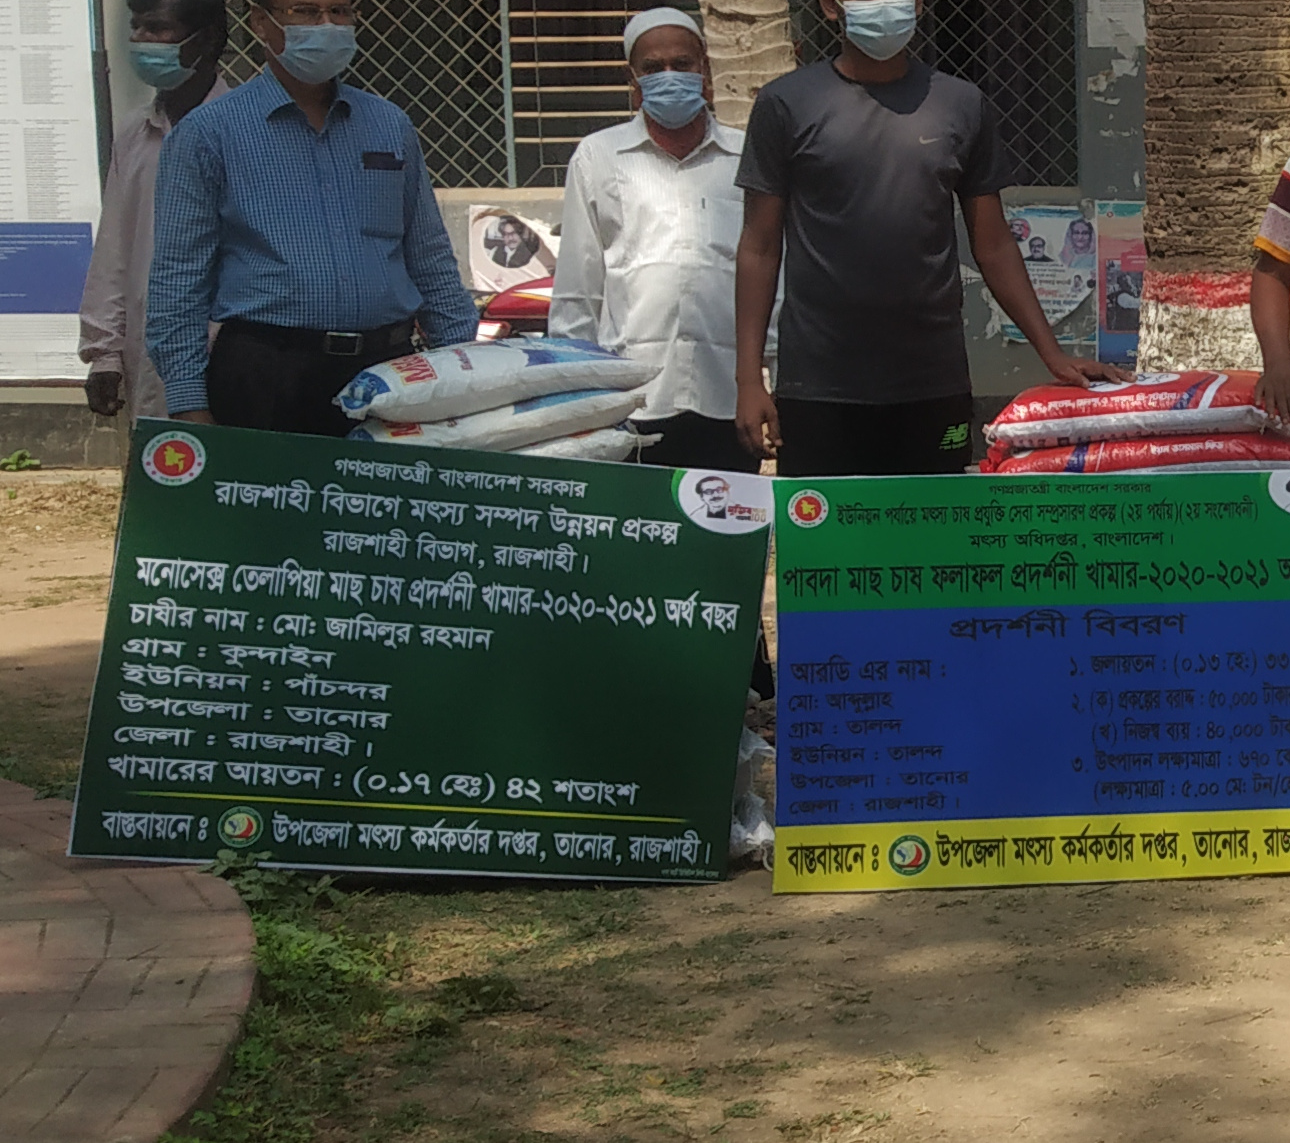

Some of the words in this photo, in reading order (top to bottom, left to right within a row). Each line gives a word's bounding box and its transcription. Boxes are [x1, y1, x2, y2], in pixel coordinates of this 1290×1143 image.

[213, 480, 315, 512] রাজশাহী
[319, 484, 403, 519] বিভাগে
[408, 498, 469, 525] মৎস্য
[473, 504, 543, 532] সম্পদ
[547, 504, 618, 540] উন্নয়ন
[620, 516, 682, 545] প্রকল্প
[322, 529, 411, 558] রাজশাহী
[135, 556, 229, 594] মনোসেক্স
[231, 561, 325, 599] তেলাপিয়া
[328, 570, 367, 605] মাছ
[369, 574, 405, 605] চাষ
[407, 573, 477, 610] প্রদর্শনী
[663, 590, 700, 628] অর্থ
[699, 600, 740, 633] বছর
[781, 565, 841, 597] পাবদা
[845, 565, 884, 598] মাছ
[888, 565, 925, 594] চাষ
[928, 561, 1005, 593] ফলাফল
[1009, 552, 1079, 593] প্রদর্শনী
[1084, 558, 1269, 593] খামার-২০২০-২০২১
[128, 597, 198, 628] চাষীর
[202, 607, 249, 632] নাম
[323, 612, 414, 646] জামিলুর
[418, 624, 494, 650] রহমান
[121, 636, 186, 658] গ্রাম
[217, 642, 336, 669] কুন্দাইন
[119, 661, 251, 691] ইউনিয়ন
[284, 672, 391, 701] পাঁচন্দর
[116, 690, 252, 720] উপজেলা
[283, 705, 392, 729] তানোর
[113, 725, 196, 746] জেলা
[107, 753, 218, 782] খামারের
[224, 761, 325, 789] আয়তন
[505, 776, 543, 803] ৪২
[551, 778, 640, 806] শতাংশ
[271, 810, 353, 848] উপজেলা
[356, 823, 406, 851] মৎস্য
[408, 817, 494, 854] কর্মকর্তার
